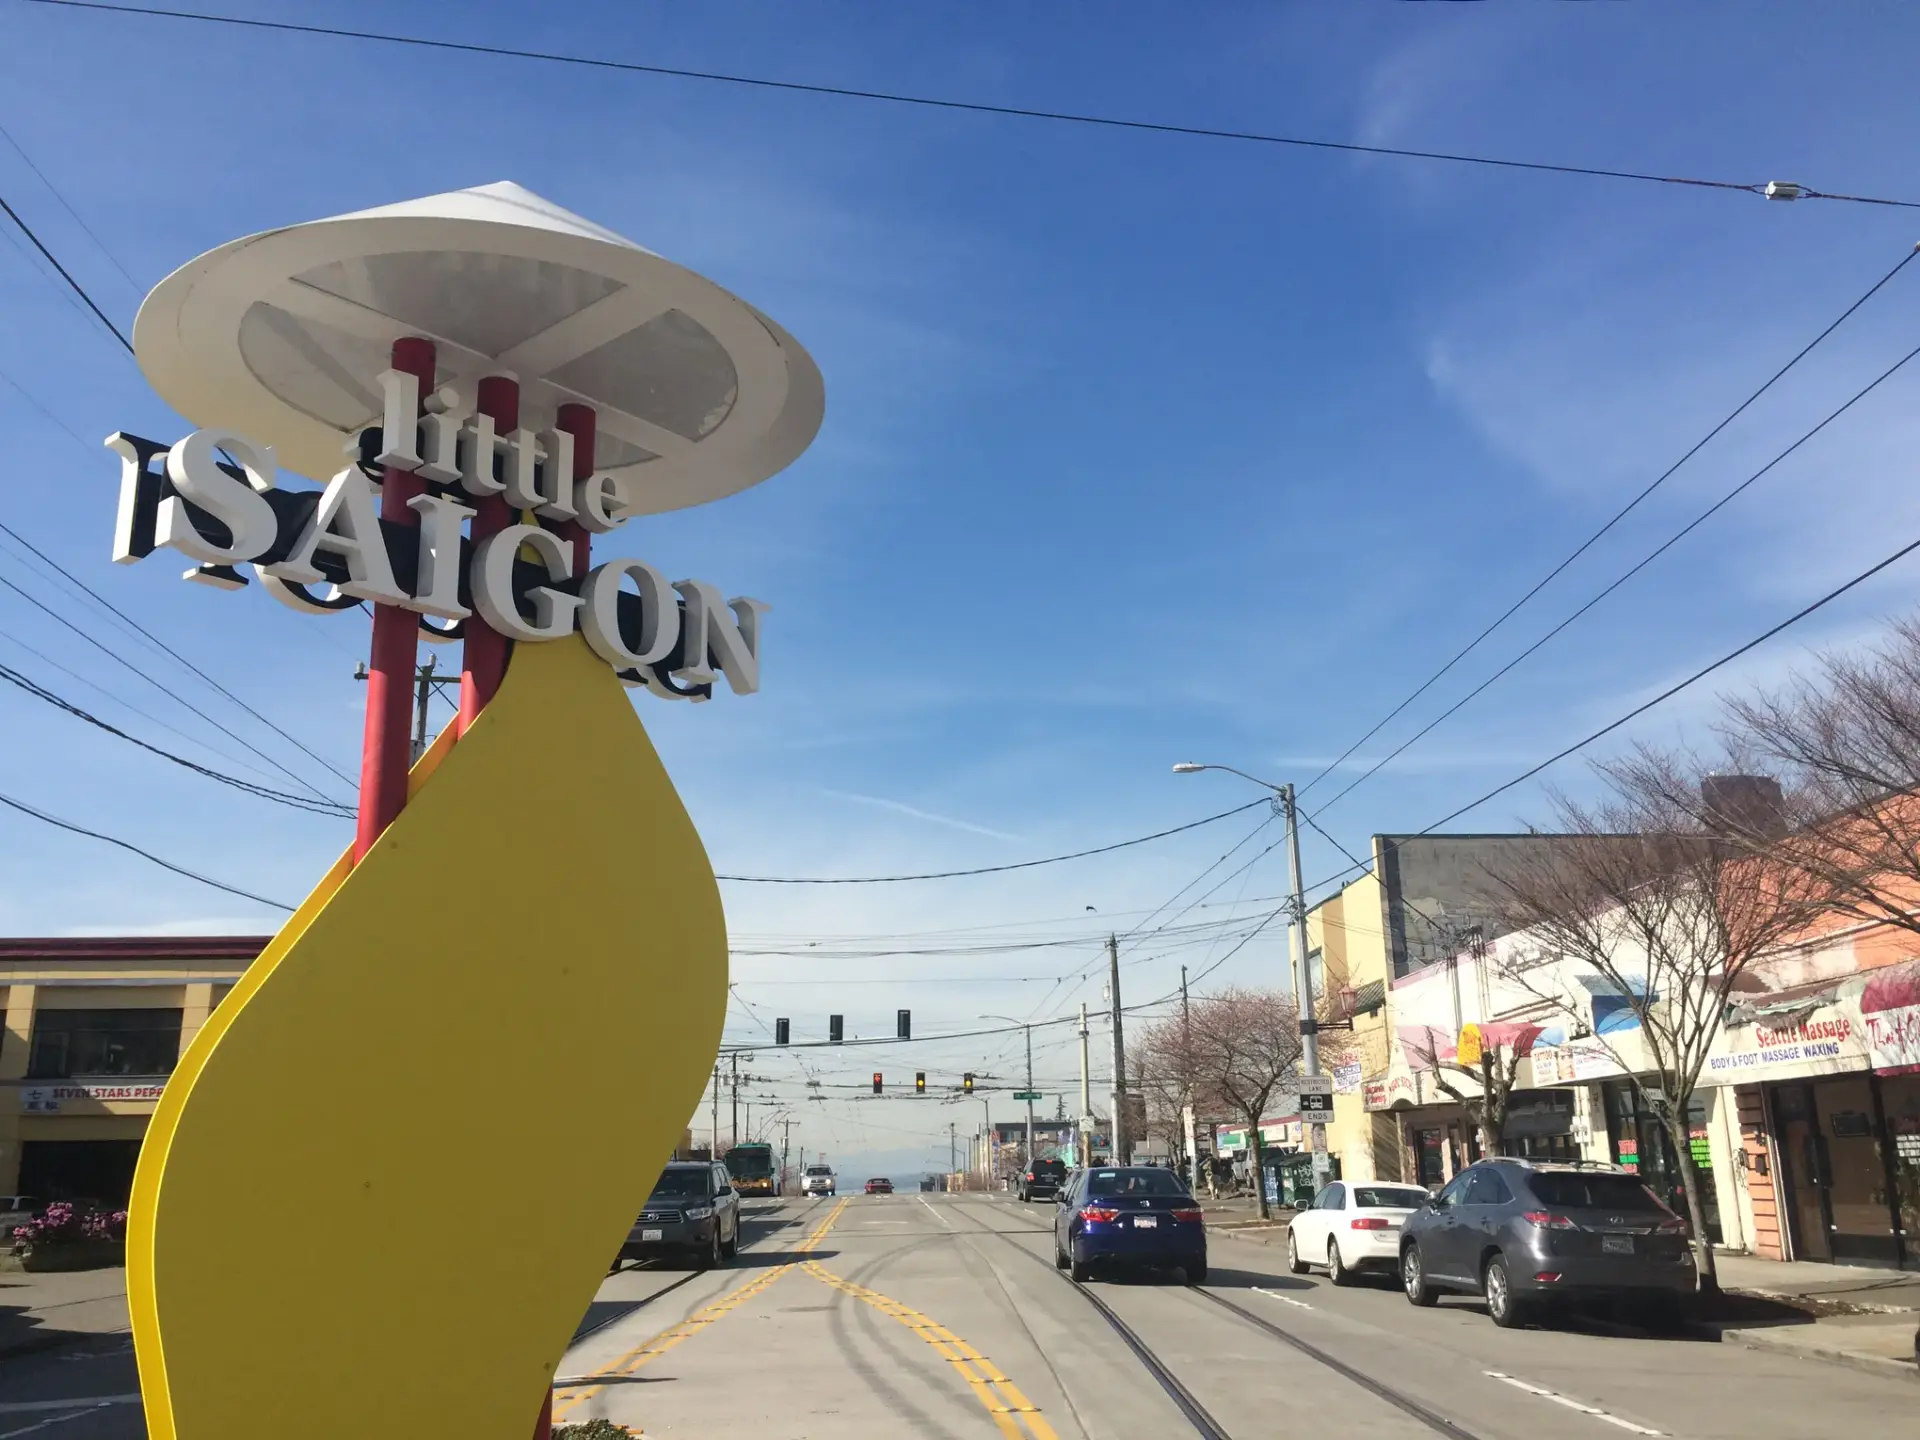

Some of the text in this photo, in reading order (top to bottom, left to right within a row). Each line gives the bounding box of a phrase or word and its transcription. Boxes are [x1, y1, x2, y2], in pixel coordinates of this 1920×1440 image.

[374, 368, 628, 534] little
[1756, 1018, 1852, 1048] Seattle Massage
[1710, 1042, 1840, 1070] BODY & FOOT MASSAGE WAXING
[52, 1087, 91, 1099] SEVEN
[93, 1087, 131, 1098] STARS
[1307, 1112, 1328, 1120] ENDS
